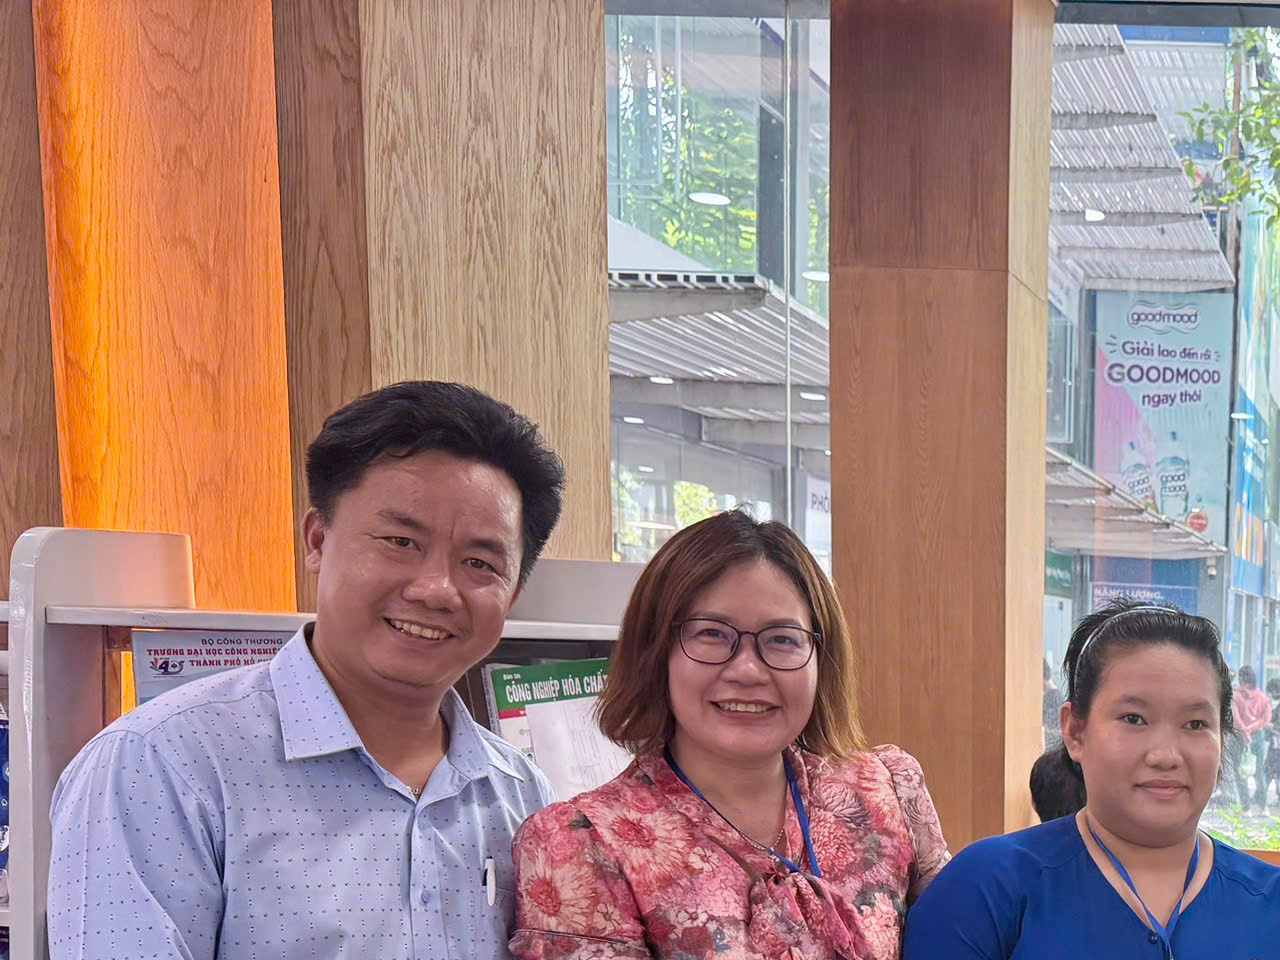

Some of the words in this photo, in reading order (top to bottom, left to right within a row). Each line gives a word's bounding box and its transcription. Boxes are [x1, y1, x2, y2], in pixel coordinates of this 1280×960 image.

[1122, 338, 1155, 357] Giải
[1157, 344, 1177, 359] lao
[1179, 346, 1198, 360] đến
[1106, 362, 1221, 385] GOODMOOD
[1141, 393, 1176, 408] ngay
[216, 636, 243, 645] CÔNG
[225, 647, 248, 655] CÔNG
[505, 681, 532, 703] CÔNG
[562, 674, 583, 696] HÓA
